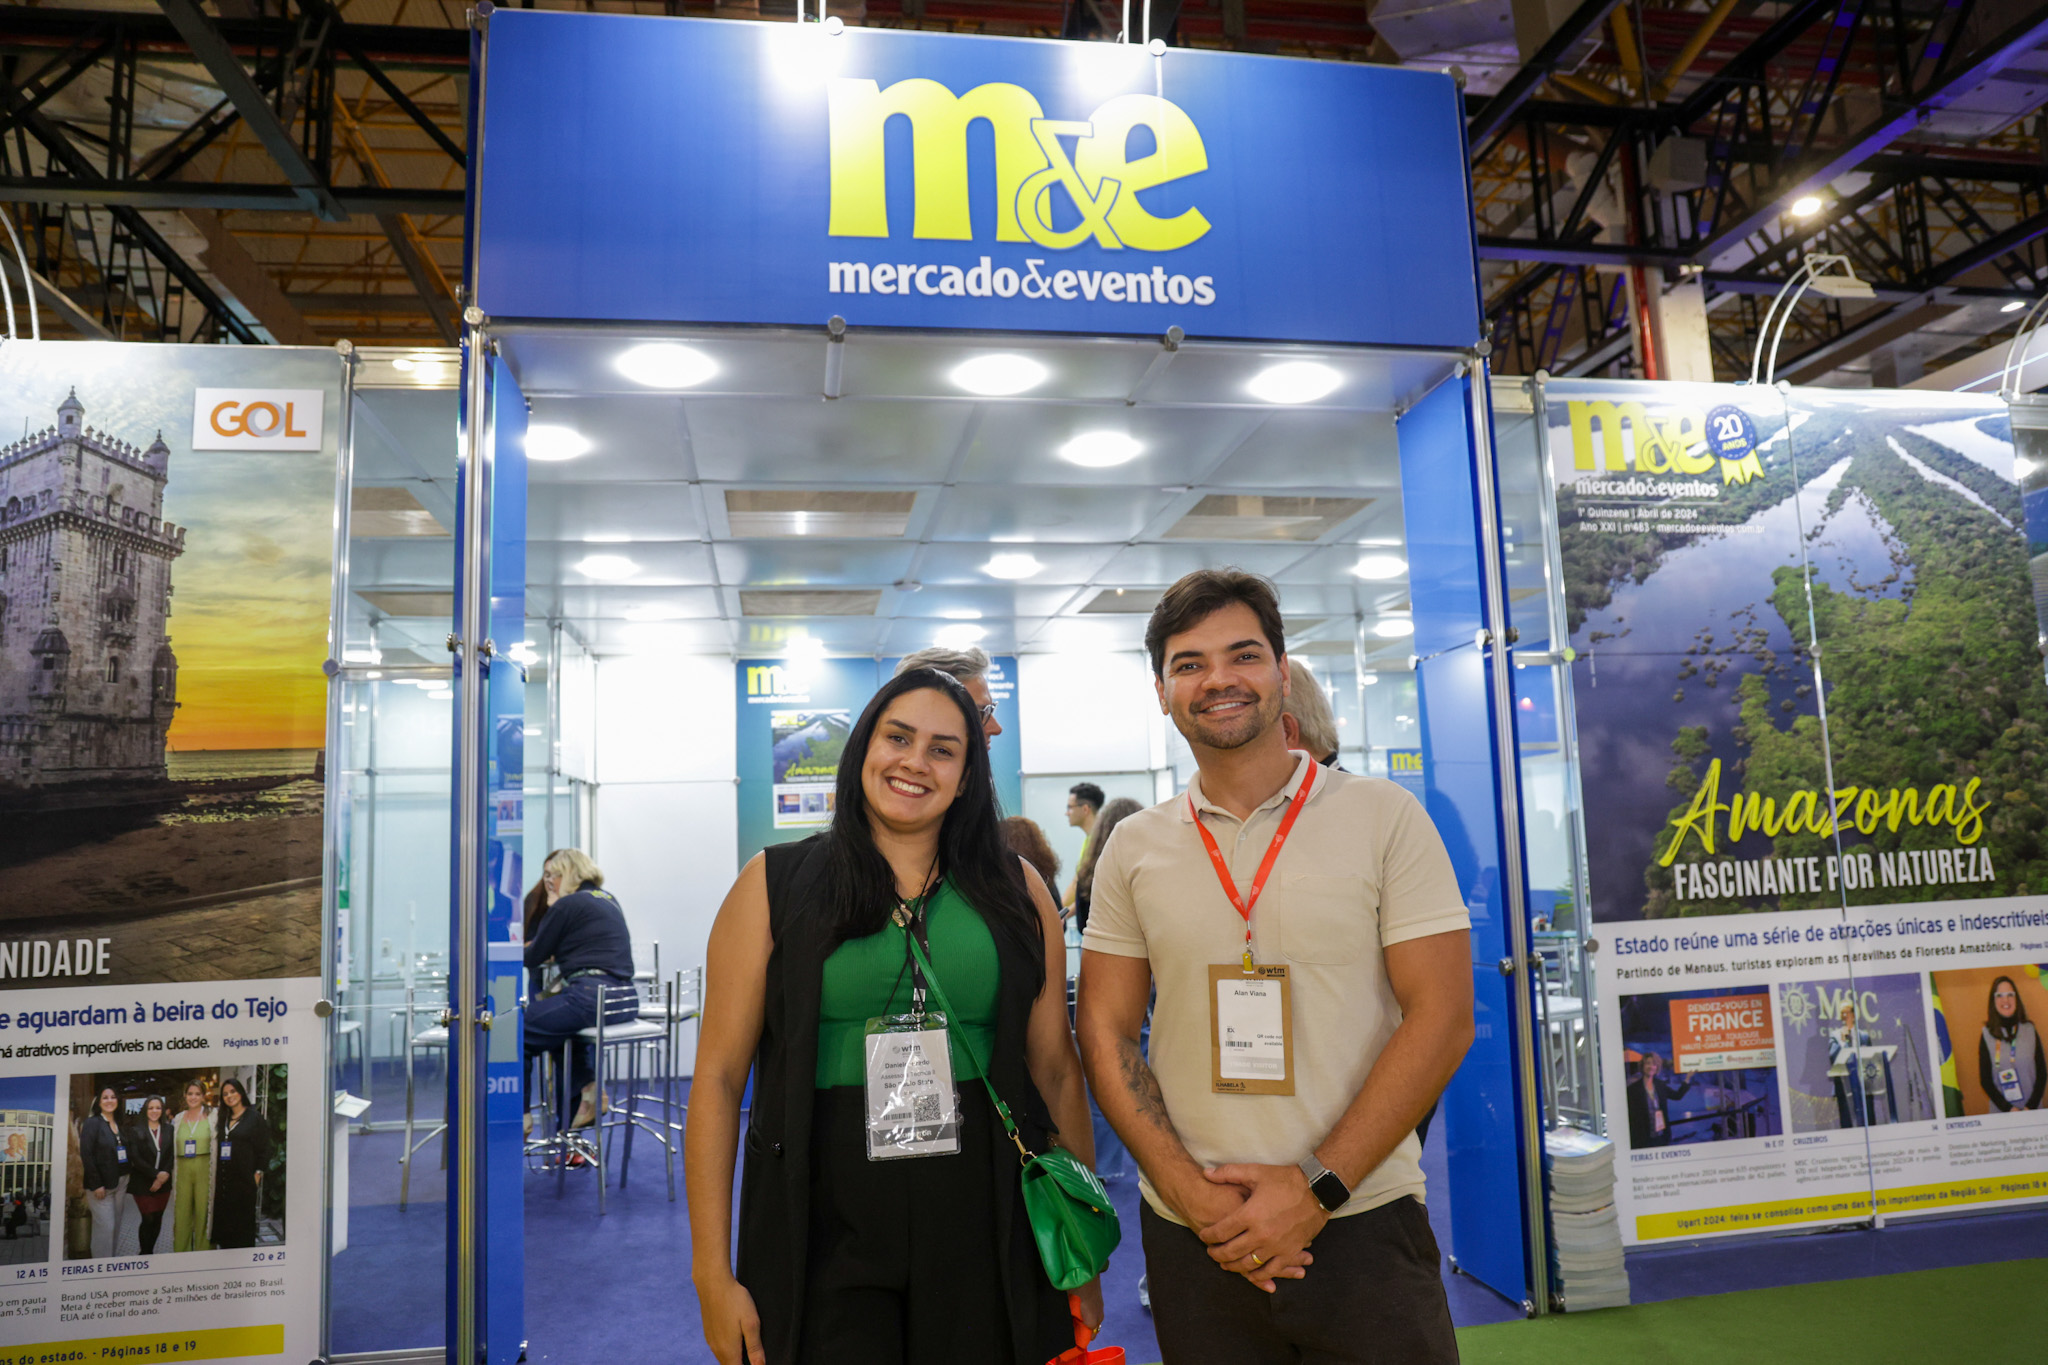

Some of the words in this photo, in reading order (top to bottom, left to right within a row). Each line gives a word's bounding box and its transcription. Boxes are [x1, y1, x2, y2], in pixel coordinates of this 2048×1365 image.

[827, 77, 1212, 251] m&e
[828, 256, 1216, 305] mercado&eventos
[210, 400, 306, 437] GOL
[1713, 413, 1745, 441] 20
[1568, 399, 1716, 474] m&e
[1722, 438, 1748, 451] ANOS
[1576, 477, 1719, 497] mercado&eventos
[1587, 508, 1629, 519] Quinzena
[1637, 508, 1659, 518] Abril
[1660, 508, 1672, 518] de
[1675, 508, 1698, 519] 2024
[1580, 522, 1598, 532] Ano
[1600, 522, 1616, 533] XXI
[1658, 758, 1992, 867] Amazonas
[1674, 856, 1822, 900] FASCINANTE
[1826, 853, 1874, 891] POR
[1880, 847, 1996, 888] NATUREZA
[1615, 936, 1669, 955] Estado
[1675, 932, 1719, 951] reúne
[1725, 932, 1757, 948] uma
[1763, 926, 1800, 945] série
[1806, 926, 1824, 942] de
[1830, 919, 1892, 942] atrações
[1897, 917, 1943, 935] únicas
[1948, 919, 1956, 931] e
[0, 938, 111, 979] NIDADE
[1617, 967, 1663, 979] Partindo
[1668, 966, 1680, 976] de
[1732, 959, 1771, 972] turistas
[1776, 956, 1823, 969] exploram
[1828, 956, 1839, 965] as
[1900, 948, 1912, 958] da
[1916, 946, 1955, 957] Floresta
[17, 1005, 127, 1034] aguardam
[133, 1001, 146, 1022] à
[153, 1000, 205, 1022] beira
[211, 999, 238, 1019] do
[244, 996, 288, 1023] Tejo
[1688, 1010, 1764, 1032] FRANCE
[16, 1043, 69, 1058] atrativos
[72, 1038, 144, 1057] imperdíveis
[148, 1040, 163, 1051] na
[166, 1036, 210, 1050] cidade.
[223, 1038, 258, 1049] Páginas
[261, 1037, 271, 1046] 10
[282, 1036, 288, 1045] 11
[1631, 1153, 1653, 1162] FEIRAS
[1661, 1150, 1691, 1160] EVENTOS
[1730, 1212, 1749, 1222] feira
[1752, 1211, 1762, 1220] se
[1765, 1206, 1804, 1219] consolida
[1807, 1204, 1828, 1214] como
[1832, 1202, 1848, 1211] uma
[1851, 1198, 1865, 1209] das
[253, 1253, 265, 1261] 20
[277, 1251, 286, 1260] 21
[16, 1270, 26, 1279] 12
[28, 1269, 36, 1278] A
[39, 1268, 48, 1277] 15
[62, 1265, 94, 1275] FEIRAS
[98, 1264, 103, 1272] E
[106, 1261, 149, 1272] EVENTOS
[22, 1296, 47, 1308] pauta
[60, 1303, 83, 1312] Meta
[86, 1301, 91, 1309] é
[95, 1299, 126, 1309] receber
[130, 1297, 149, 1306] mais
[152, 1296, 163, 1304] de
[166, 1295, 172, 1303] 2
[175, 1293, 208, 1303] milhões
[211, 1292, 221, 1300] de
[225, 1289, 268, 1300] brasileiros
[61, 1293, 87, 1301] Brand
[90, 1291, 109, 1299] USA
[112, 1288, 150, 1299] promove
[161, 1285, 183, 1294] Sales
[187, 1283, 219, 1292] Mission
[223, 1281, 242, 1289] 2024
[32, 1306, 46, 1314] mil
[60, 1313, 79, 1322] EUA
[82, 1311, 95, 1320] até
[106, 1308, 126, 1318] final
[129, 1307, 139, 1317] do
[142, 1308, 160, 1316] ano.
[19, 1354, 34, 1365] do
[41, 1351, 87, 1362] estado.
[102, 1345, 150, 1358] Páginas
[155, 1343, 167, 1353] 18
[173, 1344, 179, 1352] e
[185, 1340, 196, 1350] 19
